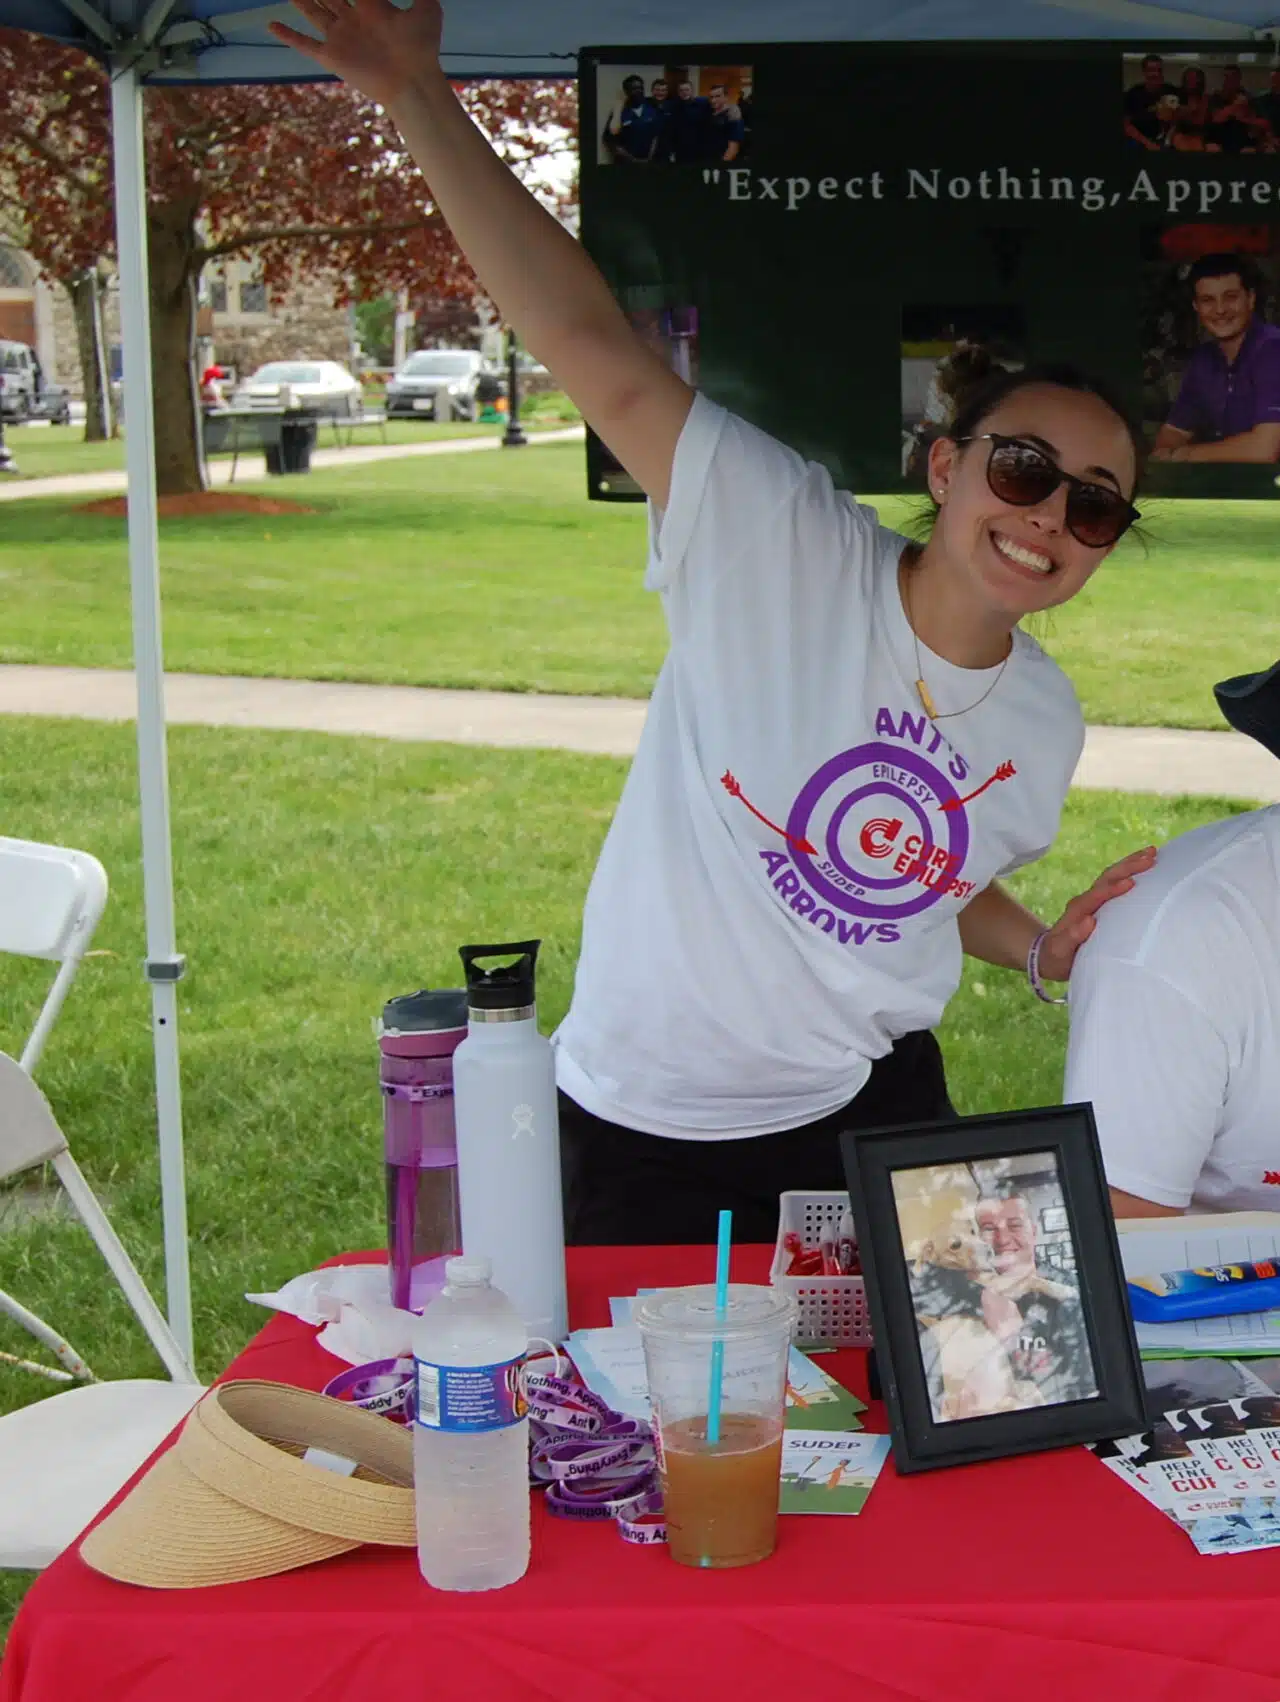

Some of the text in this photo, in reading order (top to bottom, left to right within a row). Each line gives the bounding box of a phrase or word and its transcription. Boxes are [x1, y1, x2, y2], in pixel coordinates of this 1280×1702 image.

[872, 764, 936, 804] EPILEPSY
[904, 835, 961, 871] CURE
[817, 861, 866, 898] SUDEP
[893, 852, 977, 899] EPILEPSY
[759, 850, 901, 945] ARROWS
[788, 1440, 862, 1450] SUDEP
[1160, 1460, 1201, 1473] HELP
